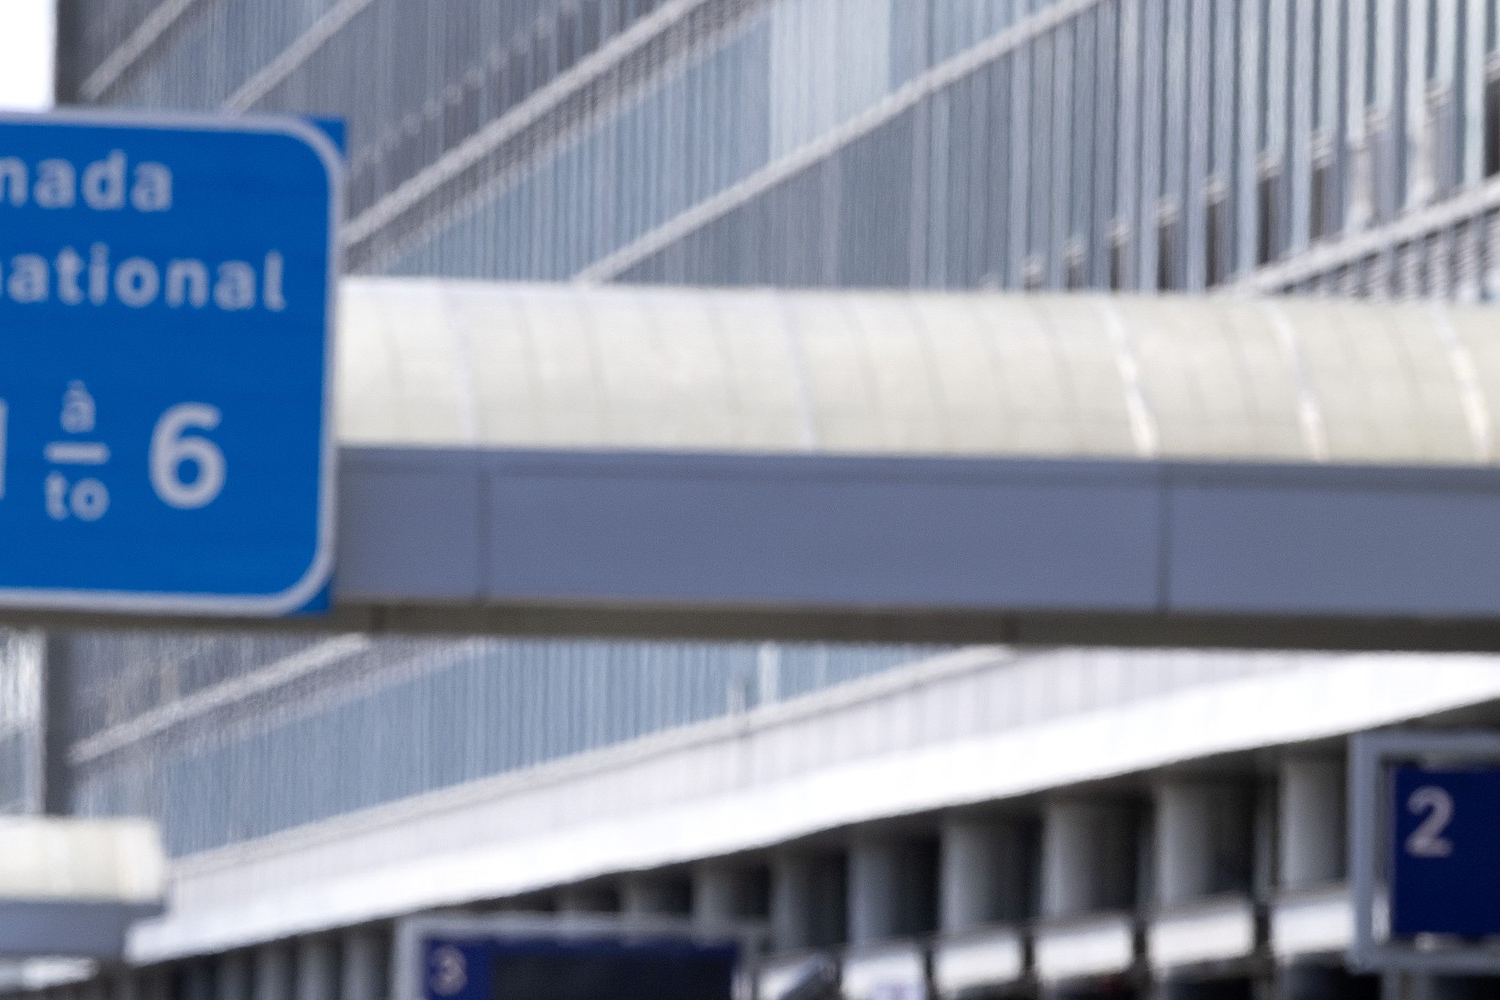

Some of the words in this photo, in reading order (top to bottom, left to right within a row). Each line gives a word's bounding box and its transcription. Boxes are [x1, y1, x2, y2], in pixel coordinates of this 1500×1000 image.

[61, 381, 96, 433] à
[149, 402, 226, 509] 6
[45, 472, 109, 520] to
[1407, 786, 1454, 858] 2
[428, 947, 467, 997] 3
